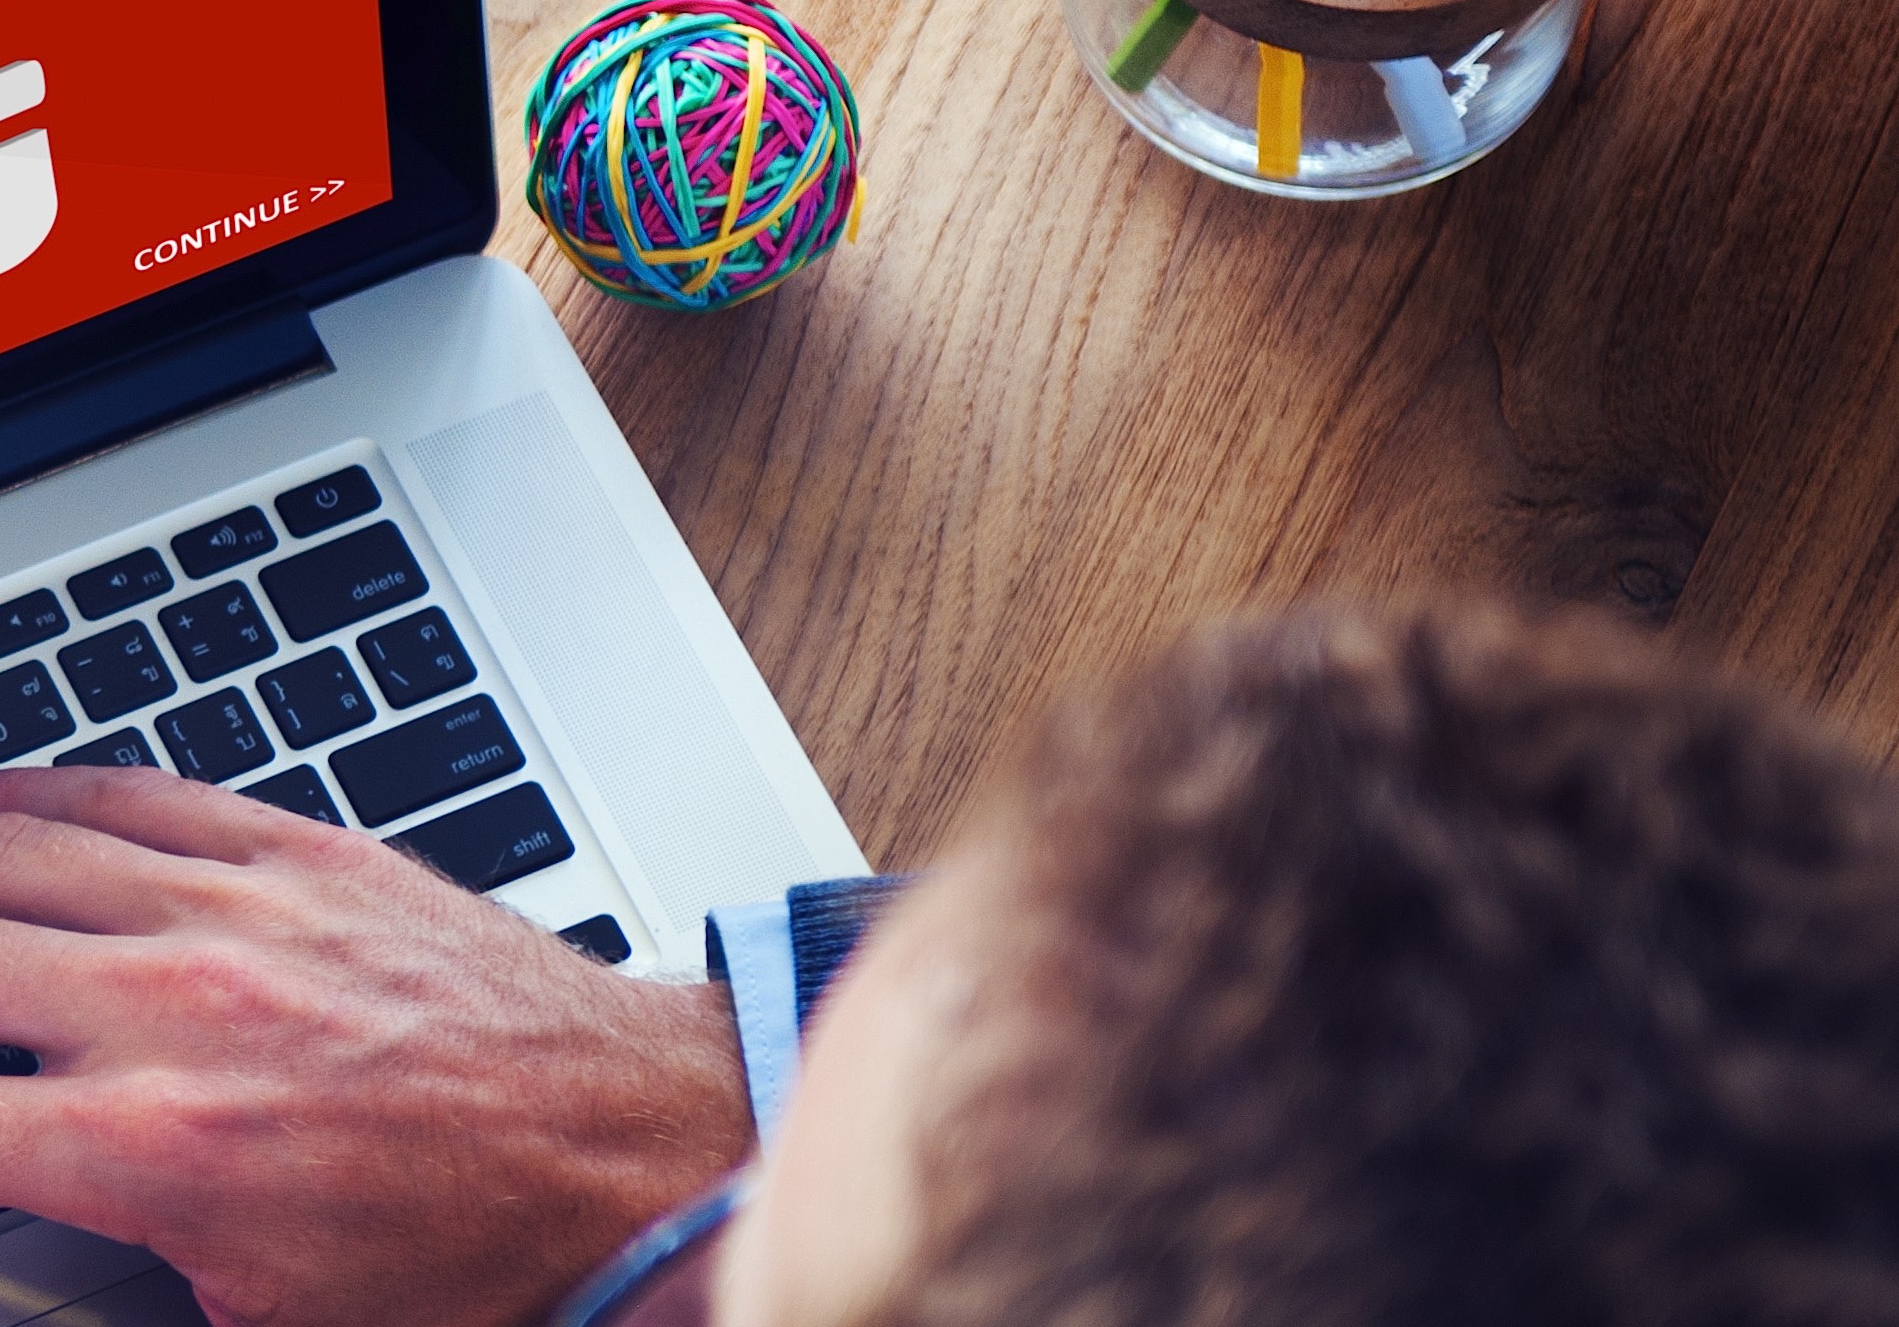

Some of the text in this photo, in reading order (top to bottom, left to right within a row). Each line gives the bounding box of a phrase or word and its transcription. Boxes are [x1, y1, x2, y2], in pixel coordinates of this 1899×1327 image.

[133, 189, 301, 272] CONTINUE
[352, 572, 406, 601] delete
[445, 706, 482, 731] enter
[451, 745, 504, 773] return
[513, 831, 551, 857] shift
